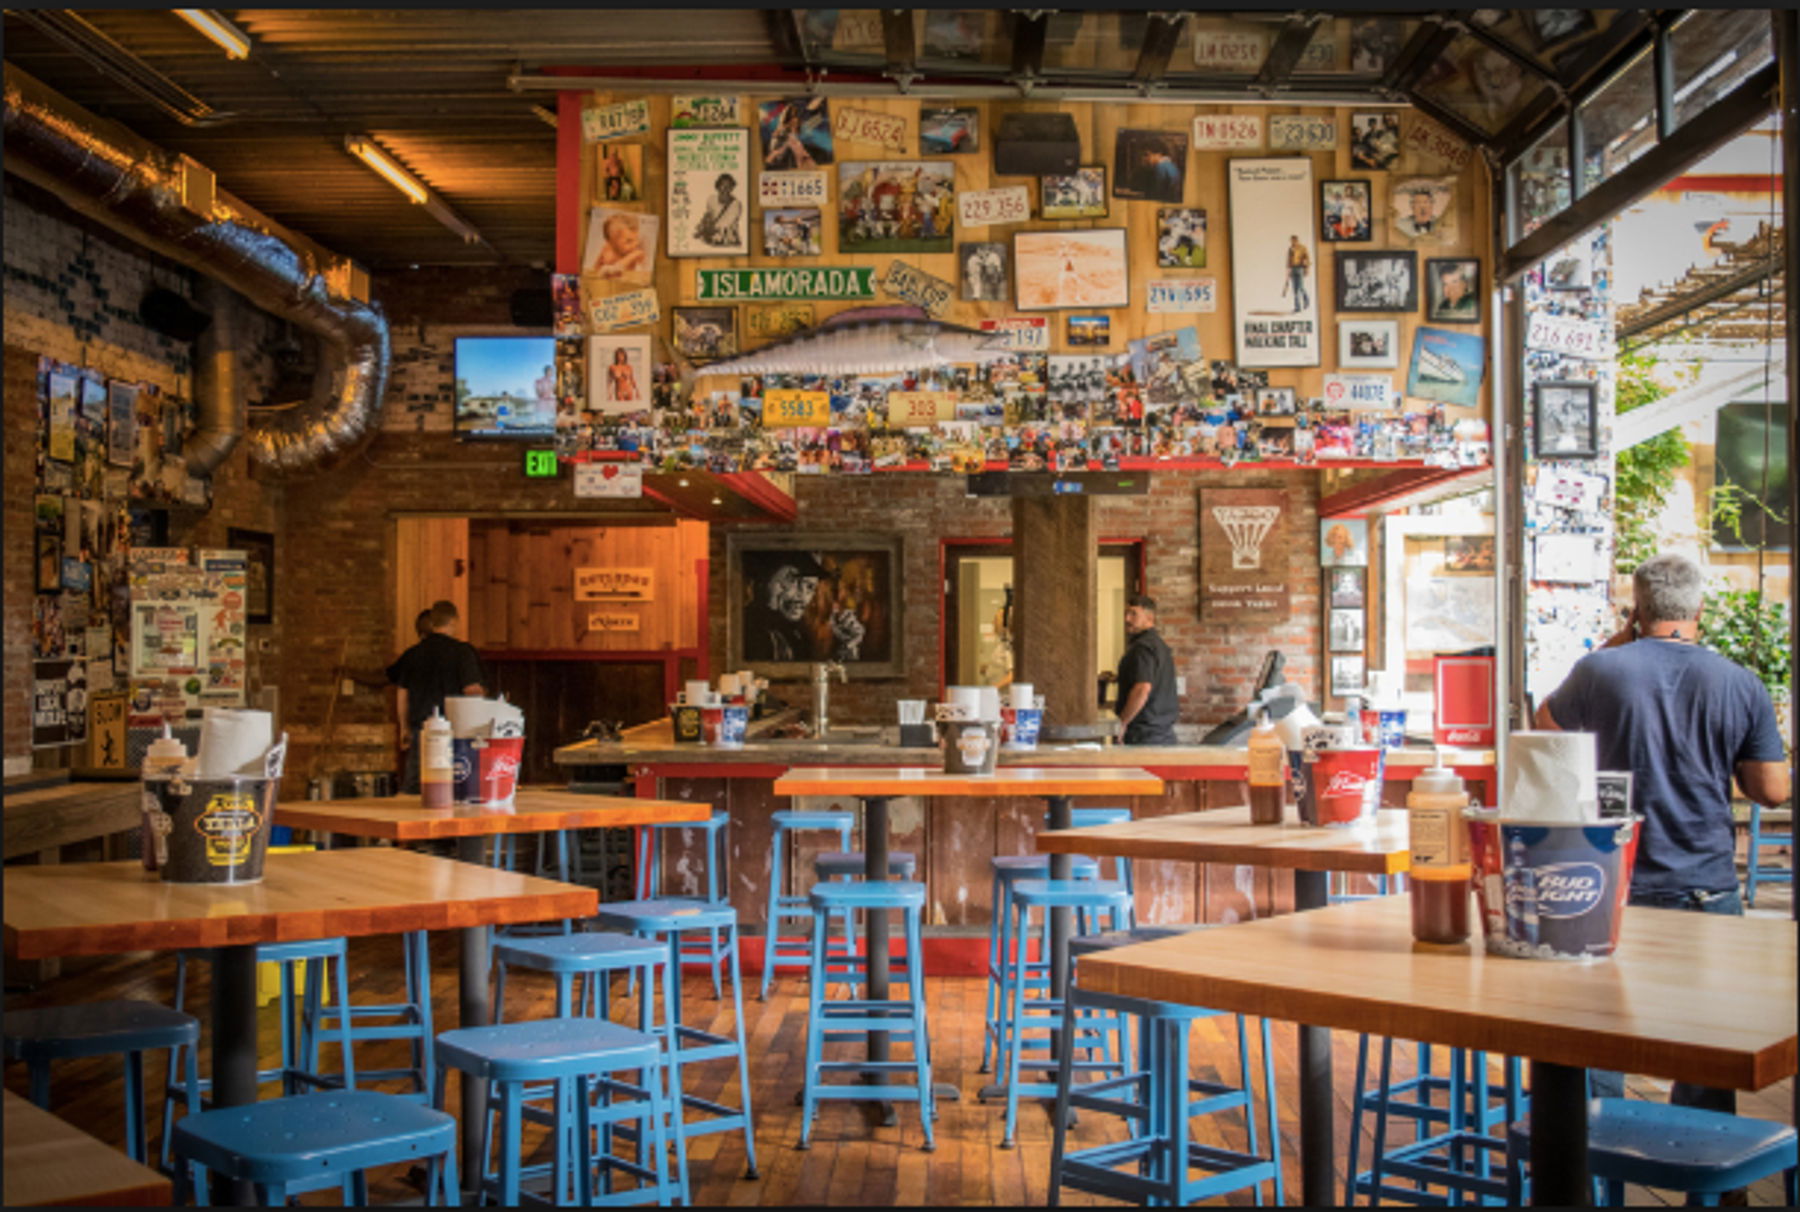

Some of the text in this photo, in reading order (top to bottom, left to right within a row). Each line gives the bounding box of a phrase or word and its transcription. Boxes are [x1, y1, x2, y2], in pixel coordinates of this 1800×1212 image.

[1220, 119, 1257, 138] 0526
[712, 271, 860, 296] ISLAMORADA
[1245, 320, 1312, 333] FINAL CHAPTER
[1288, 335, 1307, 348] TALL
[908, 400, 936, 416] 303
[527, 451, 557, 476] EXIT
[1538, 876, 1594, 889] BUD
